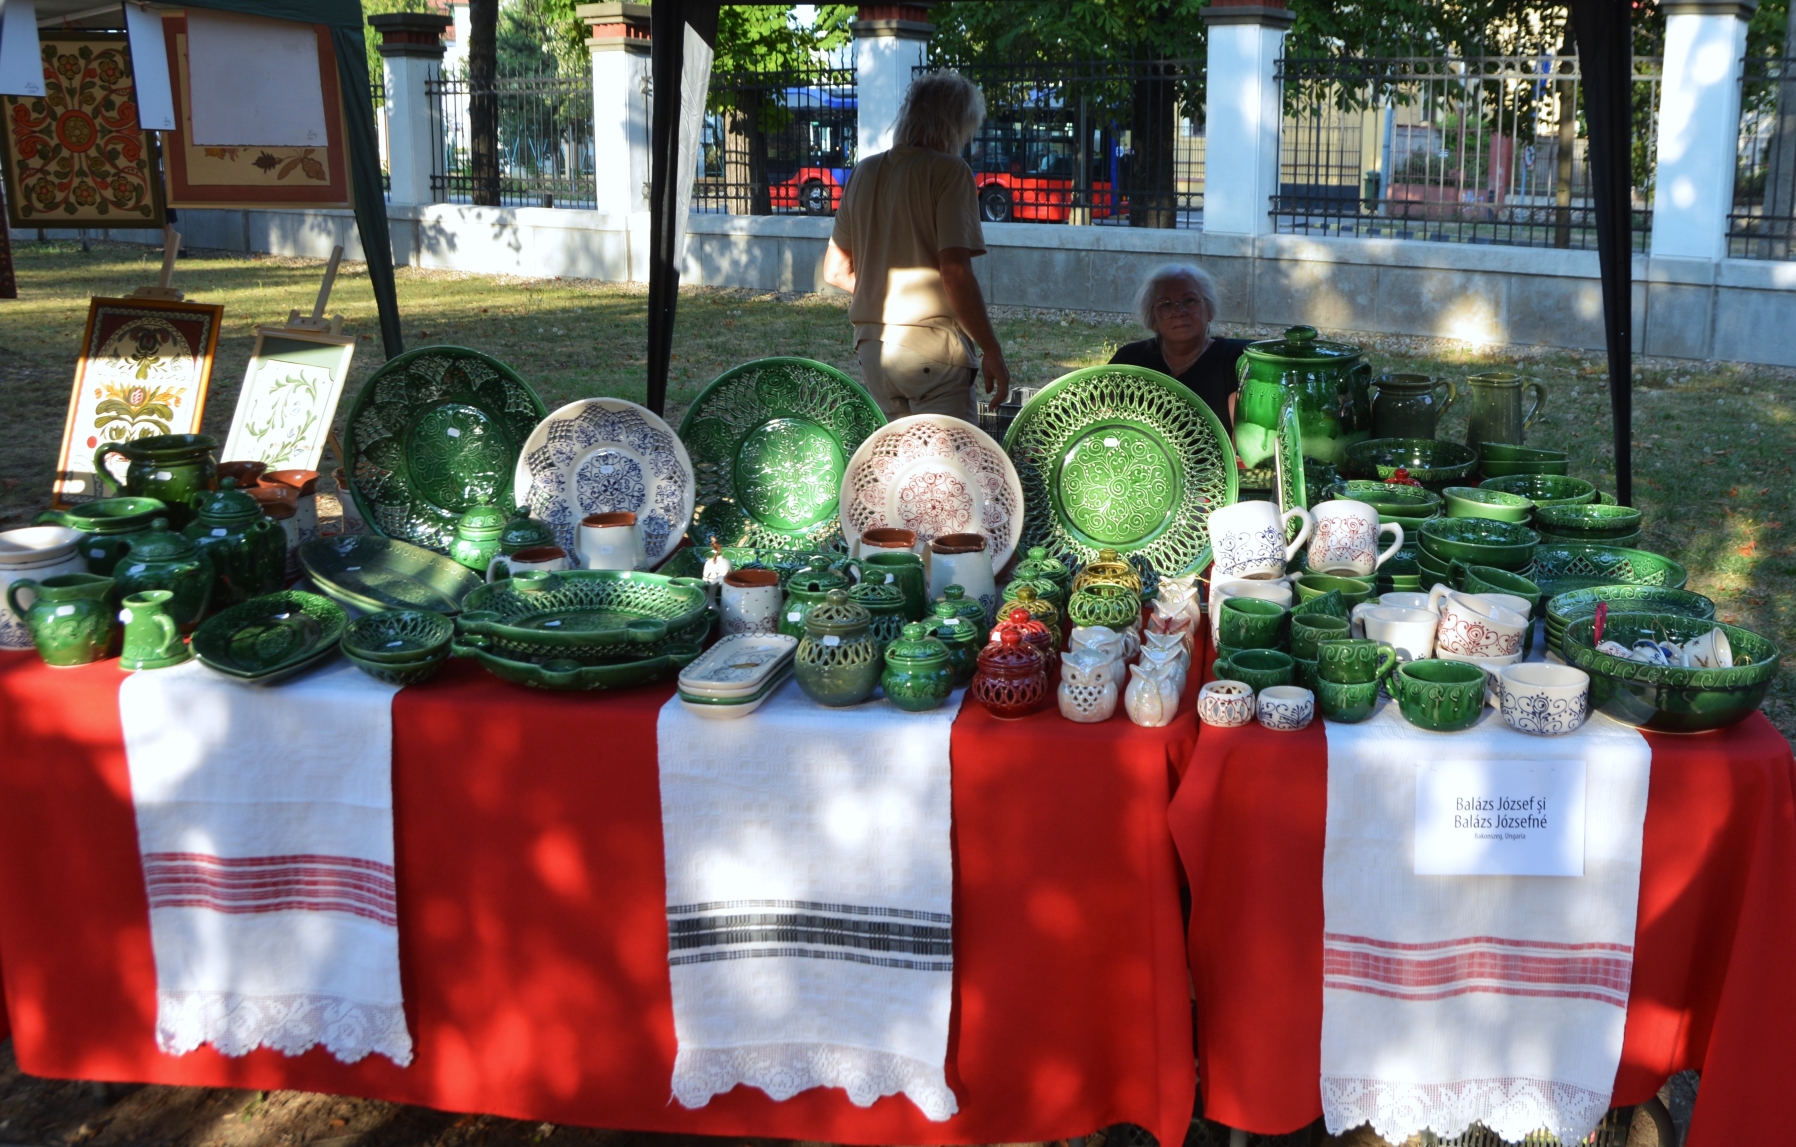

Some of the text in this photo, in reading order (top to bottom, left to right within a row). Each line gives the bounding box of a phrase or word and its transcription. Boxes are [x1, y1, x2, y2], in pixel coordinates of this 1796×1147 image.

[1456, 796, 1494, 811] Balázs
[1497, 796, 1535, 811] József
[1454, 814, 1547, 829] Balázs Józsefné
[1504, 832, 1526, 841] Ungaria
